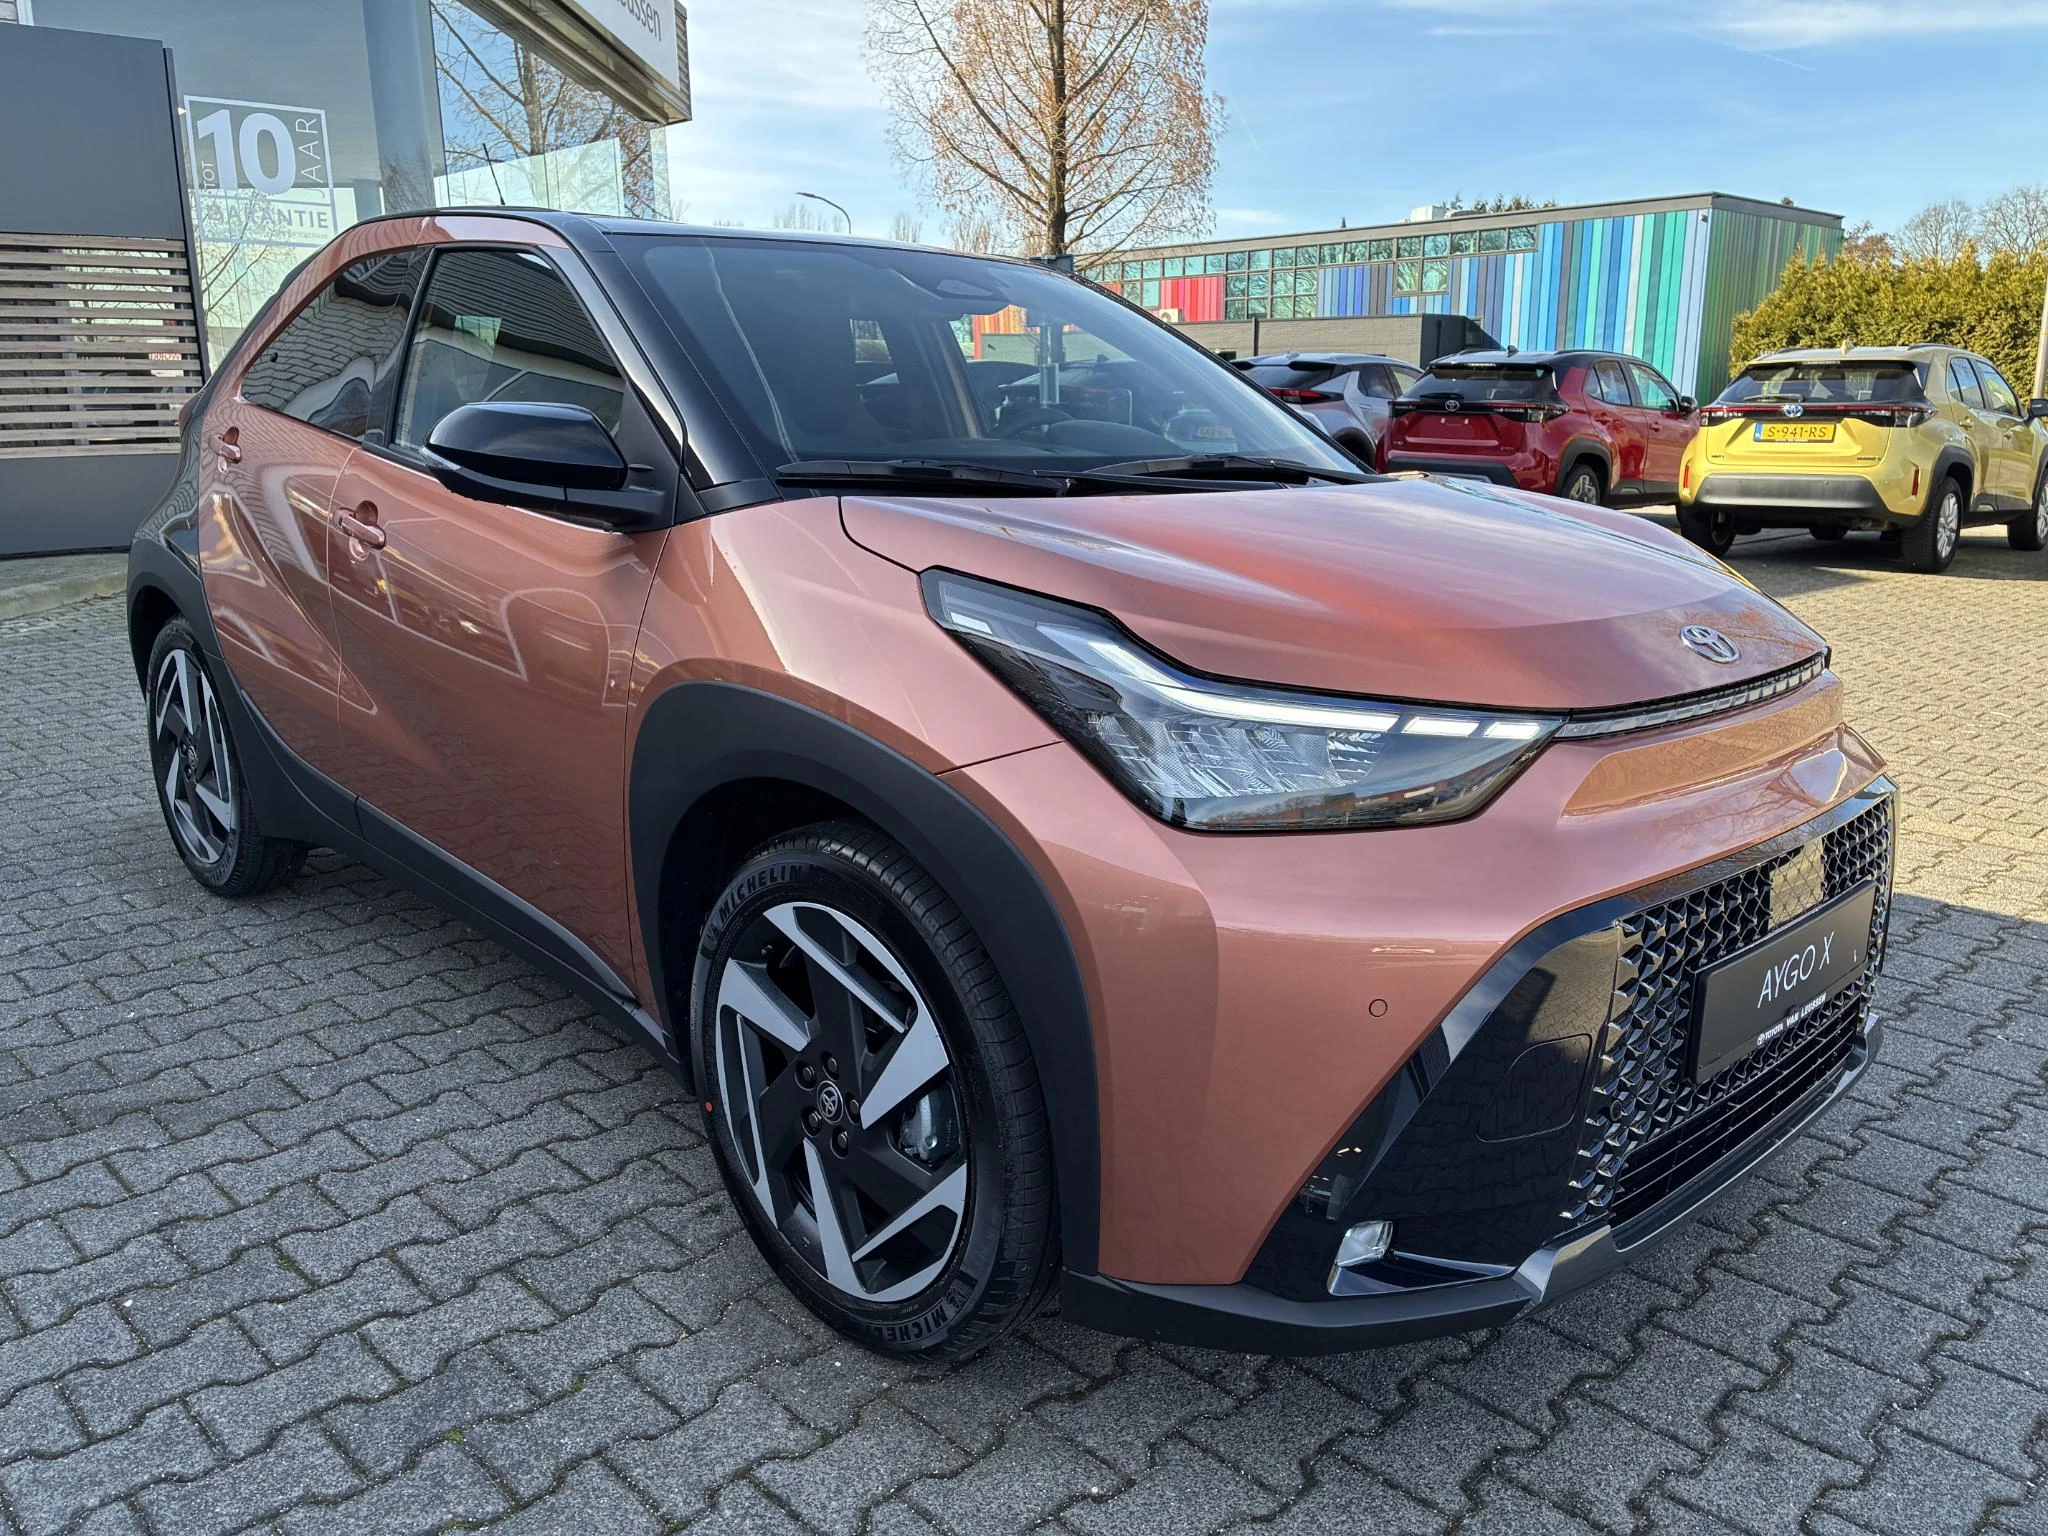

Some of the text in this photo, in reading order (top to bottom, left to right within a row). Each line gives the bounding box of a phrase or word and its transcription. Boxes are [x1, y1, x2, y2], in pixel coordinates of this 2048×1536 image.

[619, 0, 662, 42] ussen
[196, 109, 326, 200] TOT 10 JAAR
[1767, 426, 1827, 438] S-941-RS
[718, 864, 803, 924] MICHELIN
[1757, 930, 1835, 1009] AYGO X
[1765, 991, 1827, 1040] TOYOTA VAN LEUSSEN
